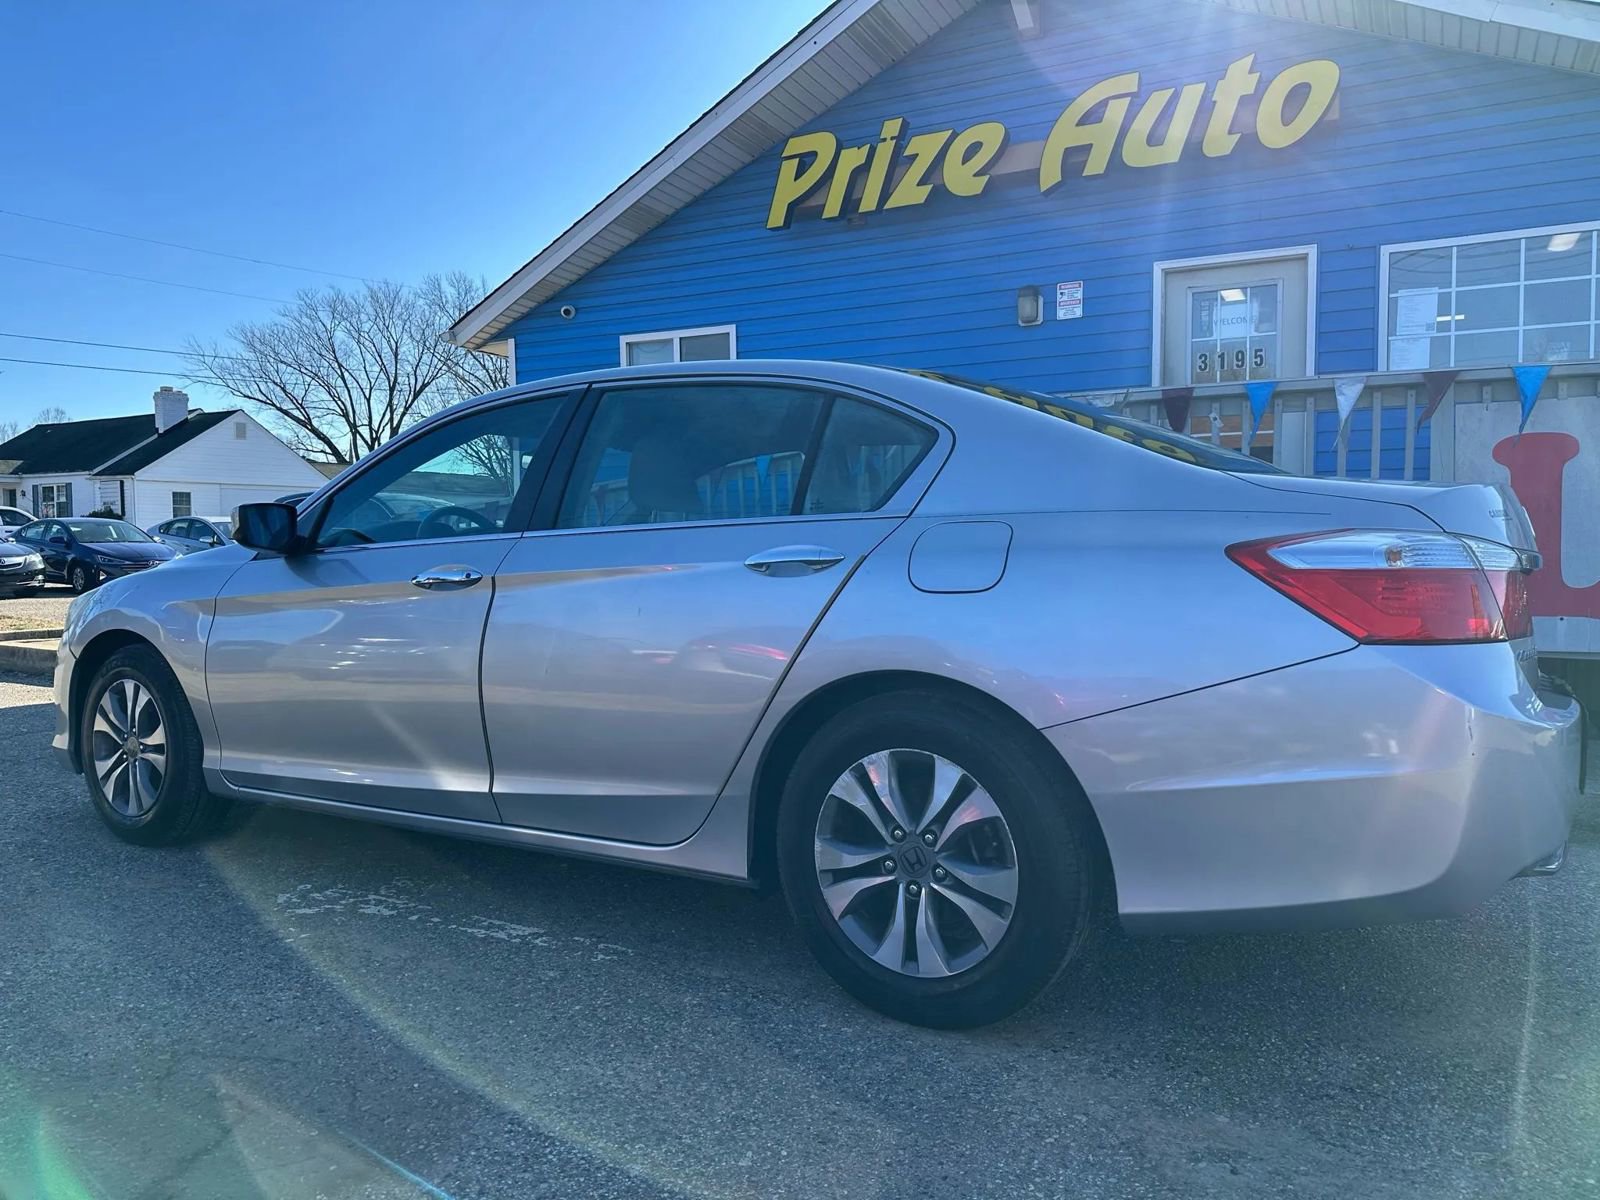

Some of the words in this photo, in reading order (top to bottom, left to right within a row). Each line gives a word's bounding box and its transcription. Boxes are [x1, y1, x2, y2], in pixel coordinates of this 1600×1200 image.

[765, 117, 1007, 229] Prize
[1038, 52, 1341, 194] Auto
[1198, 348, 1264, 372] 3195
